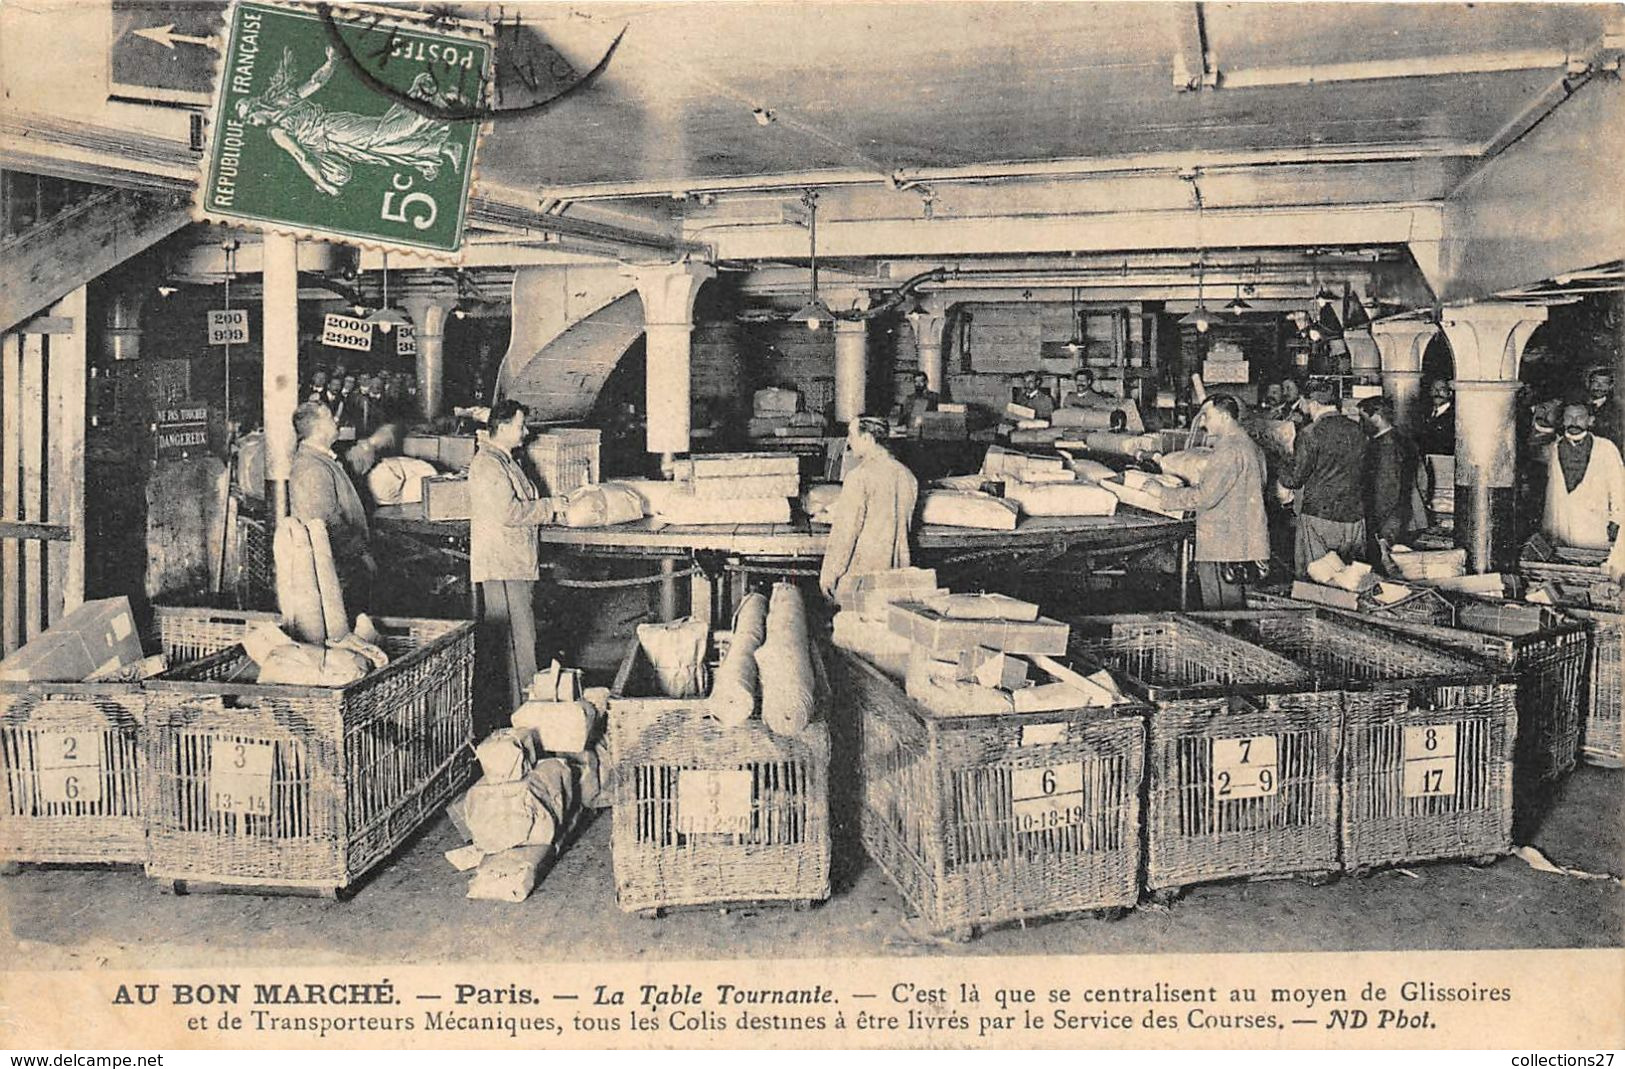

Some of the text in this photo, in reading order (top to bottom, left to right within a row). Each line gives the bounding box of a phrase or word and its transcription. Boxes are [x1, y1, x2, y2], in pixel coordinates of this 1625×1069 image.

[232, 12, 262, 94] FRANÇAISE
[327, 316, 371, 333] 2000
[325, 331, 370, 348] 2999
[159, 432, 206, 448] DANGEREUX
[63, 737, 77, 760] 2
[1425, 728, 1437, 750] 8
[234, 745, 246, 768] 3
[1239, 739, 1251, 763] 7
[65, 776, 79, 799] 6
[1042, 769, 1056, 795] 6
[1423, 769, 1443, 793] 17
[112, 984, 159, 1005] AU
[172, 984, 241, 1005] BON
[254, 979, 401, 1005] MARCHÉ.
[455, 983, 540, 1005] Paris.
[593, 985, 624, 1005] La
[640, 984, 703, 1005] Table
[716, 984, 839, 1005] Tournante.
[960, 983, 980, 1003] là
[995, 989, 1036, 1009] que
[1048, 989, 1071, 1003] se
[1083, 983, 1217, 1003] centralisent
[1230, 988, 1256, 1002] au
[1271, 988, 1346, 1008] moyen
[1361, 982, 1386, 1001] de
[1400, 982, 1511, 1002] Glissoires
[187, 1015, 208, 1031] et
[217, 1012, 242, 1030] de
[250, 1011, 415, 1037] Transporteurs
[425, 1011, 563, 1036] Mécaniques,
[573, 1014, 621, 1031] tous
[630, 1011, 660, 1031] les
[669, 1011, 727, 1031] Colis
[835, 1010, 846, 1029] à
[856, 1010, 898, 1030] être
[908, 1010, 969, 1030] livrés
[979, 1015, 1016, 1036] par
[1025, 1010, 1044, 1029] le
[1053, 1010, 1133, 1030] Service
[1142, 1010, 1178, 1029] des
[1187, 1009, 1284, 1030] Courses.
[1326, 1010, 1368, 1030] ND
[1377, 1009, 1436, 1029] Phot.
